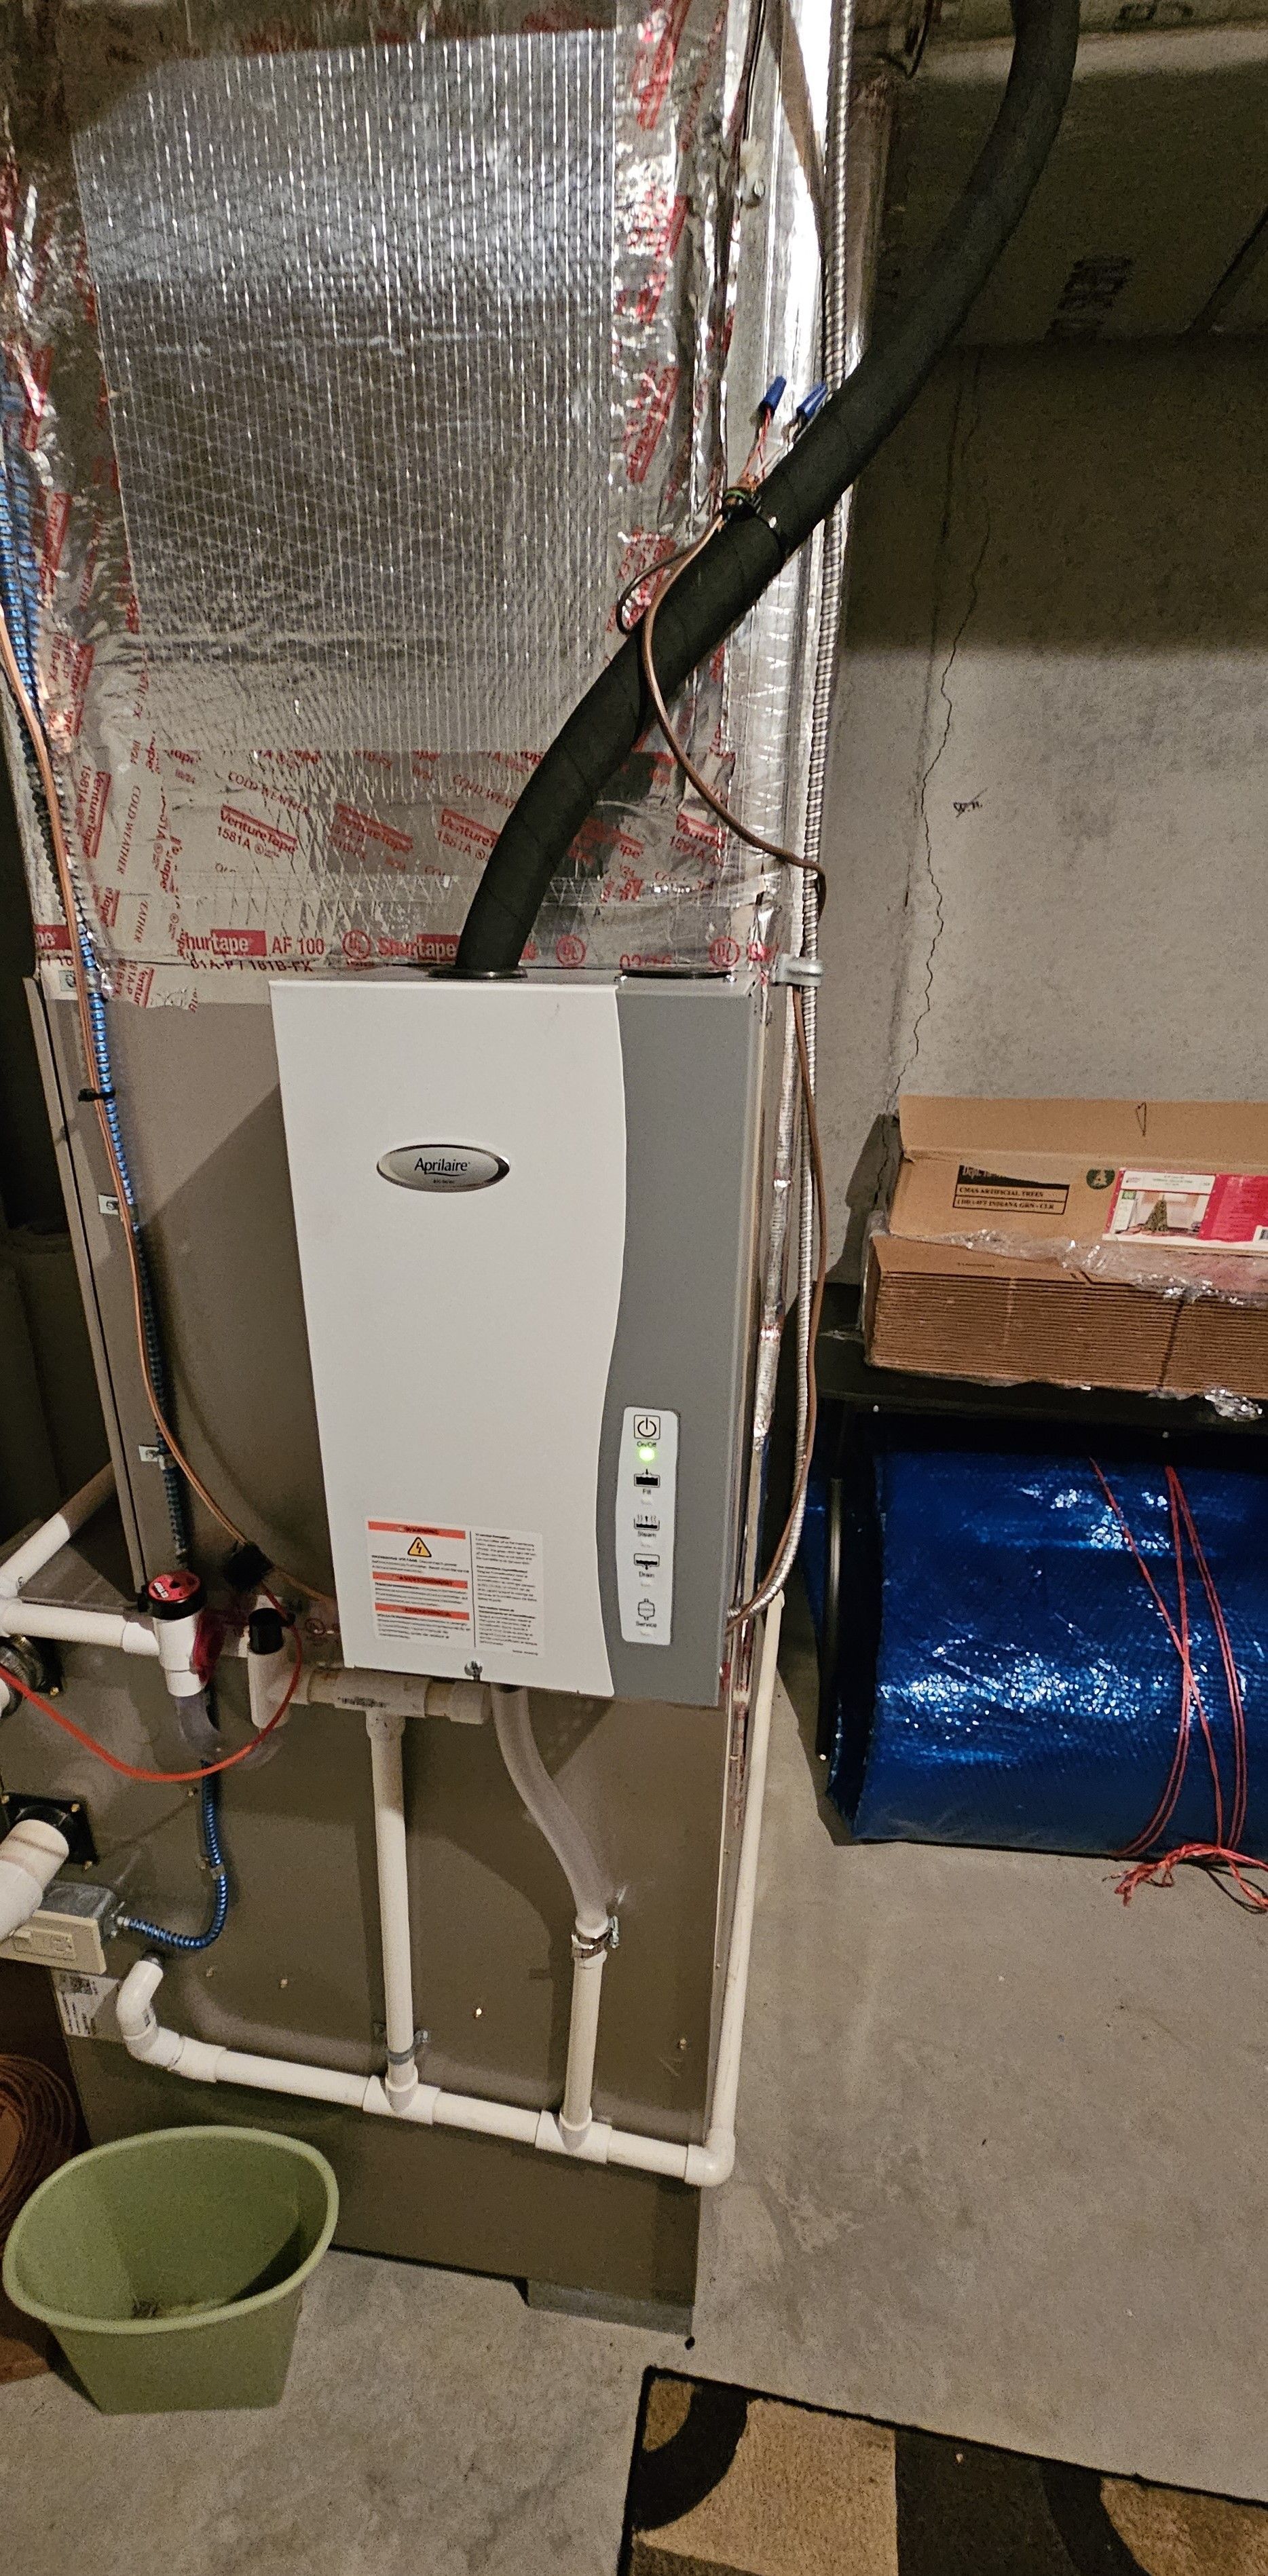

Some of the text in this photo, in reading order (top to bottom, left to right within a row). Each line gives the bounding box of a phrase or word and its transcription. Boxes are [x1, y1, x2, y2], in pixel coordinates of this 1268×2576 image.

[228, 771, 258, 791] COLD
[82, 772, 106, 859] VentureTape
[117, 785, 141, 875] COLD WEATHER
[217, 826, 250, 850] 1581A
[221, 809, 296, 853] VentureTape
[272, 935, 292, 953] AF
[298, 937, 324, 955] 100
[414, 1157, 468, 1175] Aprilaire
[635, 1620, 658, 1628] Service
